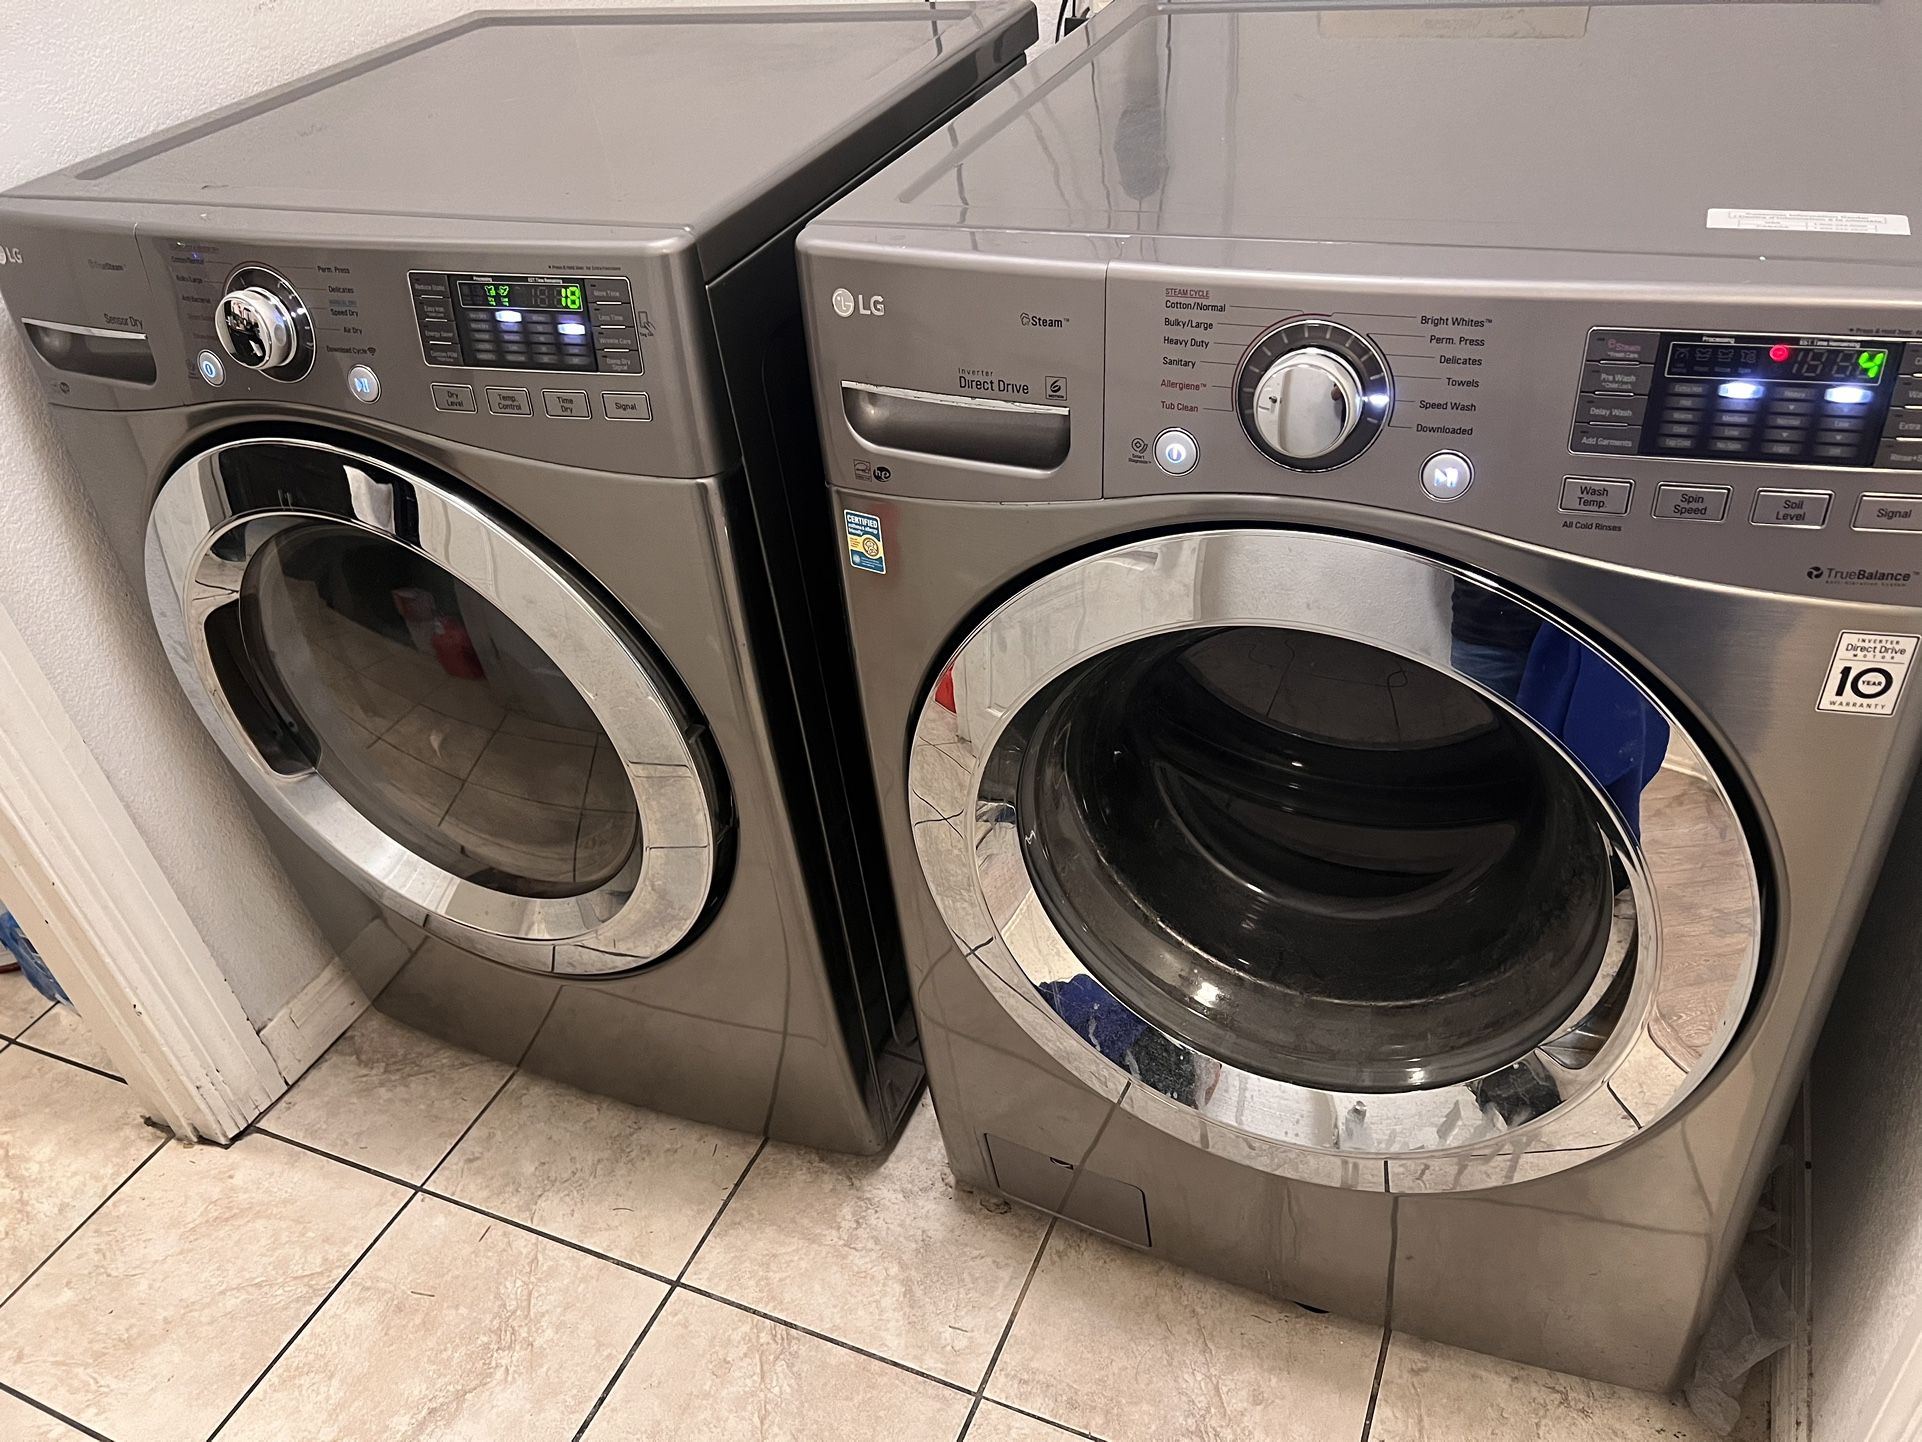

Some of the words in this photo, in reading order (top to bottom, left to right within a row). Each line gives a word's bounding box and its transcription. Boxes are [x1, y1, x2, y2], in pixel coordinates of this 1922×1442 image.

[5, 247, 23, 263] LG
[328, 285, 354, 294] Delicates
[1165, 288, 1187, 296] STEAM
[1189, 289, 1210, 298] CYCLE
[561, 286, 580, 309] 18
[858, 294, 885, 316] LG
[1165, 300, 1226, 312] Cotton/Normal
[104, 313, 129, 326] Sensor
[129, 316, 143, 329] Dry
[1164, 318, 1213, 331] Bulky/Large
[1421, 316, 1449, 327] Bright
[1163, 336, 1188, 347] Heavy
[1190, 338, 1209, 349] Duty
[1429, 335, 1456, 345] Perm.
[1459, 336, 1485, 346] Press
[1162, 357, 1196, 369] Sanitary
[1440, 355, 1482, 366] Delicates
[1859, 352, 1884, 378] 4
[958, 368, 993, 376] Inverter
[959, 376, 995, 391] Direct
[998, 380, 1029, 394] Drive
[1446, 377, 1480, 387] Towels
[447, 399, 464, 407] Level
[498, 403, 522, 411] Control
[615, 402, 637, 411] Signal
[1161, 401, 1175, 410] Tub
[1177, 402, 1198, 412] Clean
[1420, 400, 1448, 410] Speed
[1450, 401, 1476, 411] Wash
[561, 405, 573, 414] Dry
[1590, 407, 1610, 416] Delay
[1416, 423, 1473, 435] Downloaded
[1581, 436, 1596, 444] Add
[1580, 486, 1608, 497] Wash
[1577, 497, 1607, 508] Temp.
[1680, 494, 1704, 503] Spin
[1783, 500, 1803, 509] Soil
[1673, 505, 1707, 516] Speed
[1775, 511, 1806, 521] Level
[1876, 508, 1912, 519] Signal
[847, 515, 877, 529] CERTIFIED
[1562, 521, 1573, 529] All
[1574, 521, 1593, 530] Cold
[1595, 523, 1622, 532] Rinses
[1845, 643, 1876, 653] Direct
[1879, 645, 1907, 655] Drive
[1835, 666, 1893, 699] 10
[1829, 700, 1886, 710] WARRANTY
